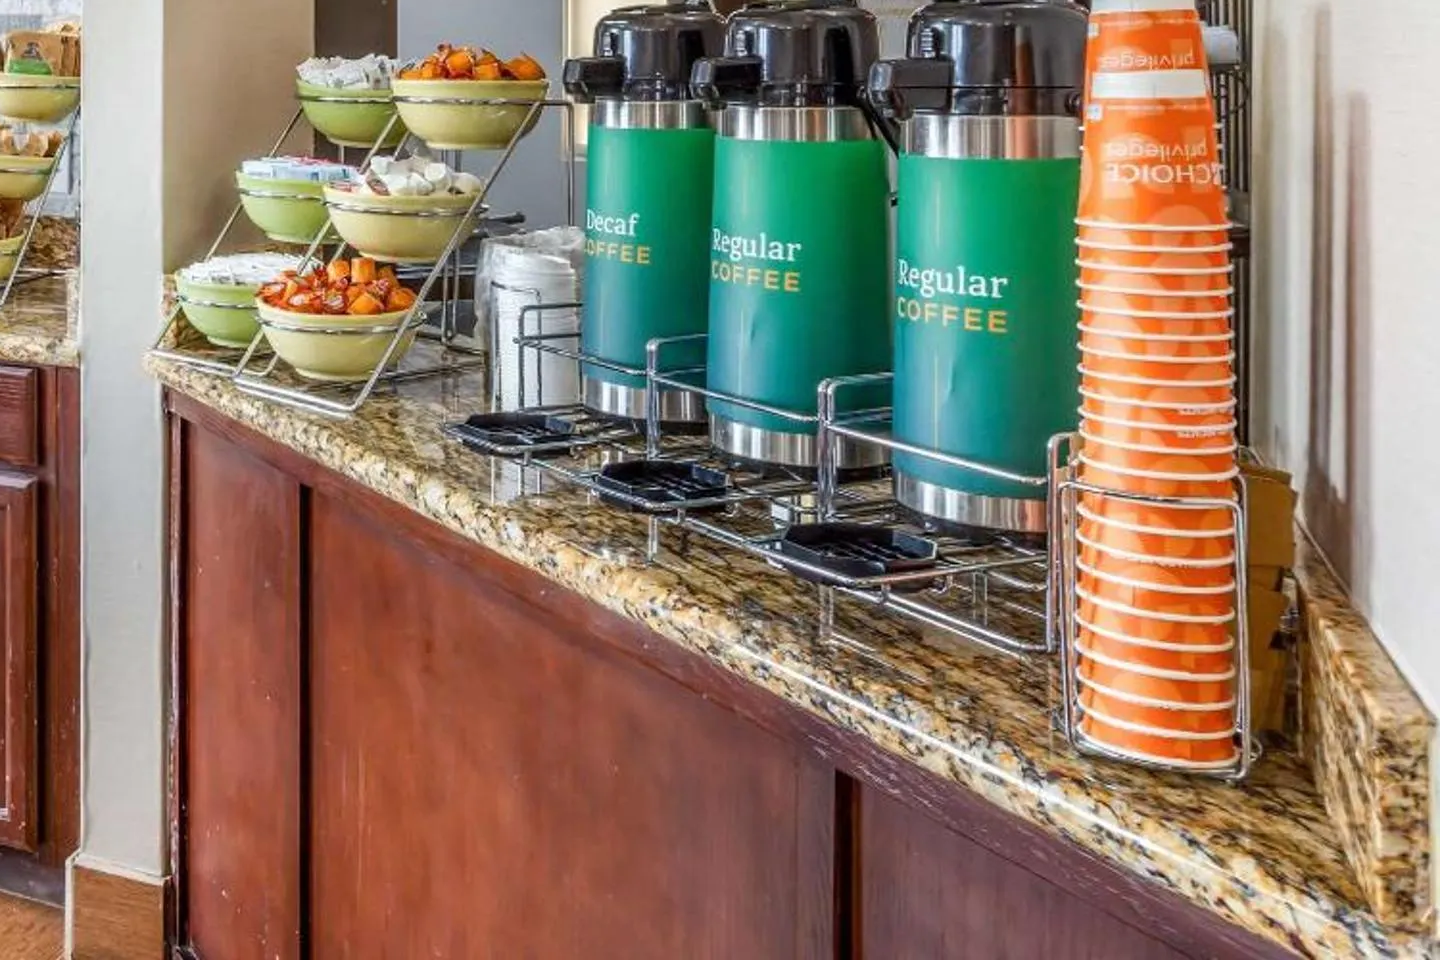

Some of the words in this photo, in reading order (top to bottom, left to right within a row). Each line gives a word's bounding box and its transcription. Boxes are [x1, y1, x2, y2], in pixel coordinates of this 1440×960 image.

[1106, 137, 1208, 162] privileges
[1105, 162, 1212, 185] CHOICE
[586, 208, 640, 237] Decaf
[584, 238, 651, 265] OFFEE
[712, 227, 802, 262] Regular
[711, 259, 801, 292] COFFEE
[897, 258, 1009, 299] Regular
[897, 296, 1009, 333] COFFEE
